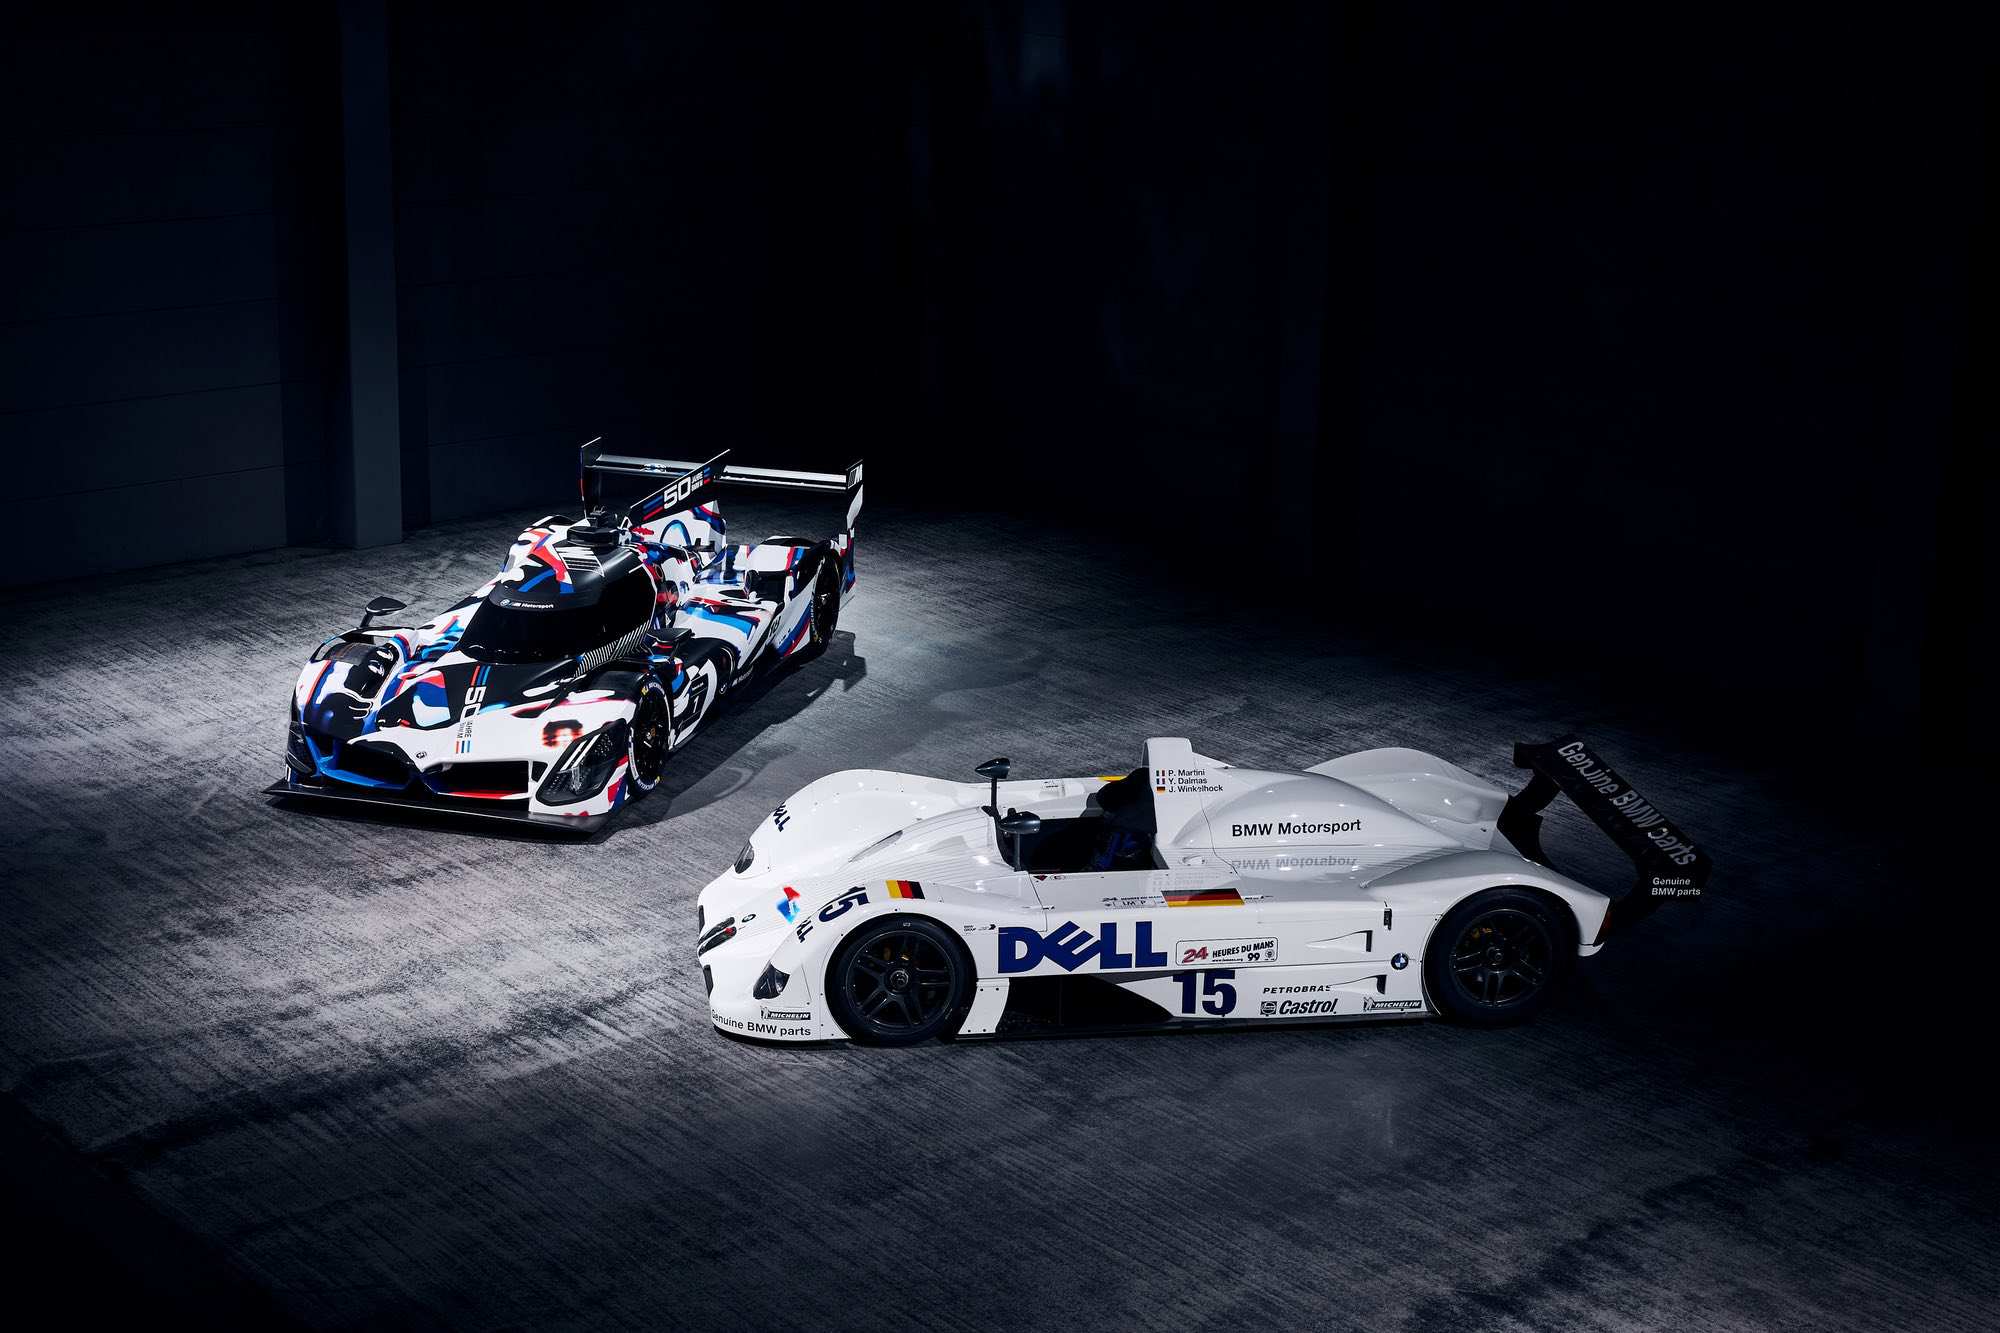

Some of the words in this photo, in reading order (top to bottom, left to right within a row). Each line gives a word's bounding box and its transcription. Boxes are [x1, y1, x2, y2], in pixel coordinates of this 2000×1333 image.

[664, 477, 691, 509] 50
[693, 696, 700, 713] 1
[1558, 741, 1619, 794] Genuine
[1609, 790, 1665, 828] BMW
[1232, 823, 1273, 837] BMW
[1278, 819, 1361, 836] Motorsport
[1652, 877, 1691, 886] Genuine
[1651, 887, 1676, 896] BMW
[1676, 887, 1701, 897] parts
[998, 920, 1168, 974] DELL
[1182, 947, 1209, 963] 24
[1213, 946, 1240, 958] HEURES
[1241, 944, 1252, 953] DU
[1253, 941, 1274, 951] MANS
[1247, 953, 1260, 961] 99
[1173, 970, 1237, 1015] 15
[1263, 985, 1331, 994] PETROBRAS
[1279, 999, 1338, 1015] Castrol
[1374, 1001, 1422, 1009] MICHELIN
[770, 1012, 810, 1020] MICHELIN
[747, 1021, 777, 1034] BMW
[780, 1027, 811, 1037] parts
